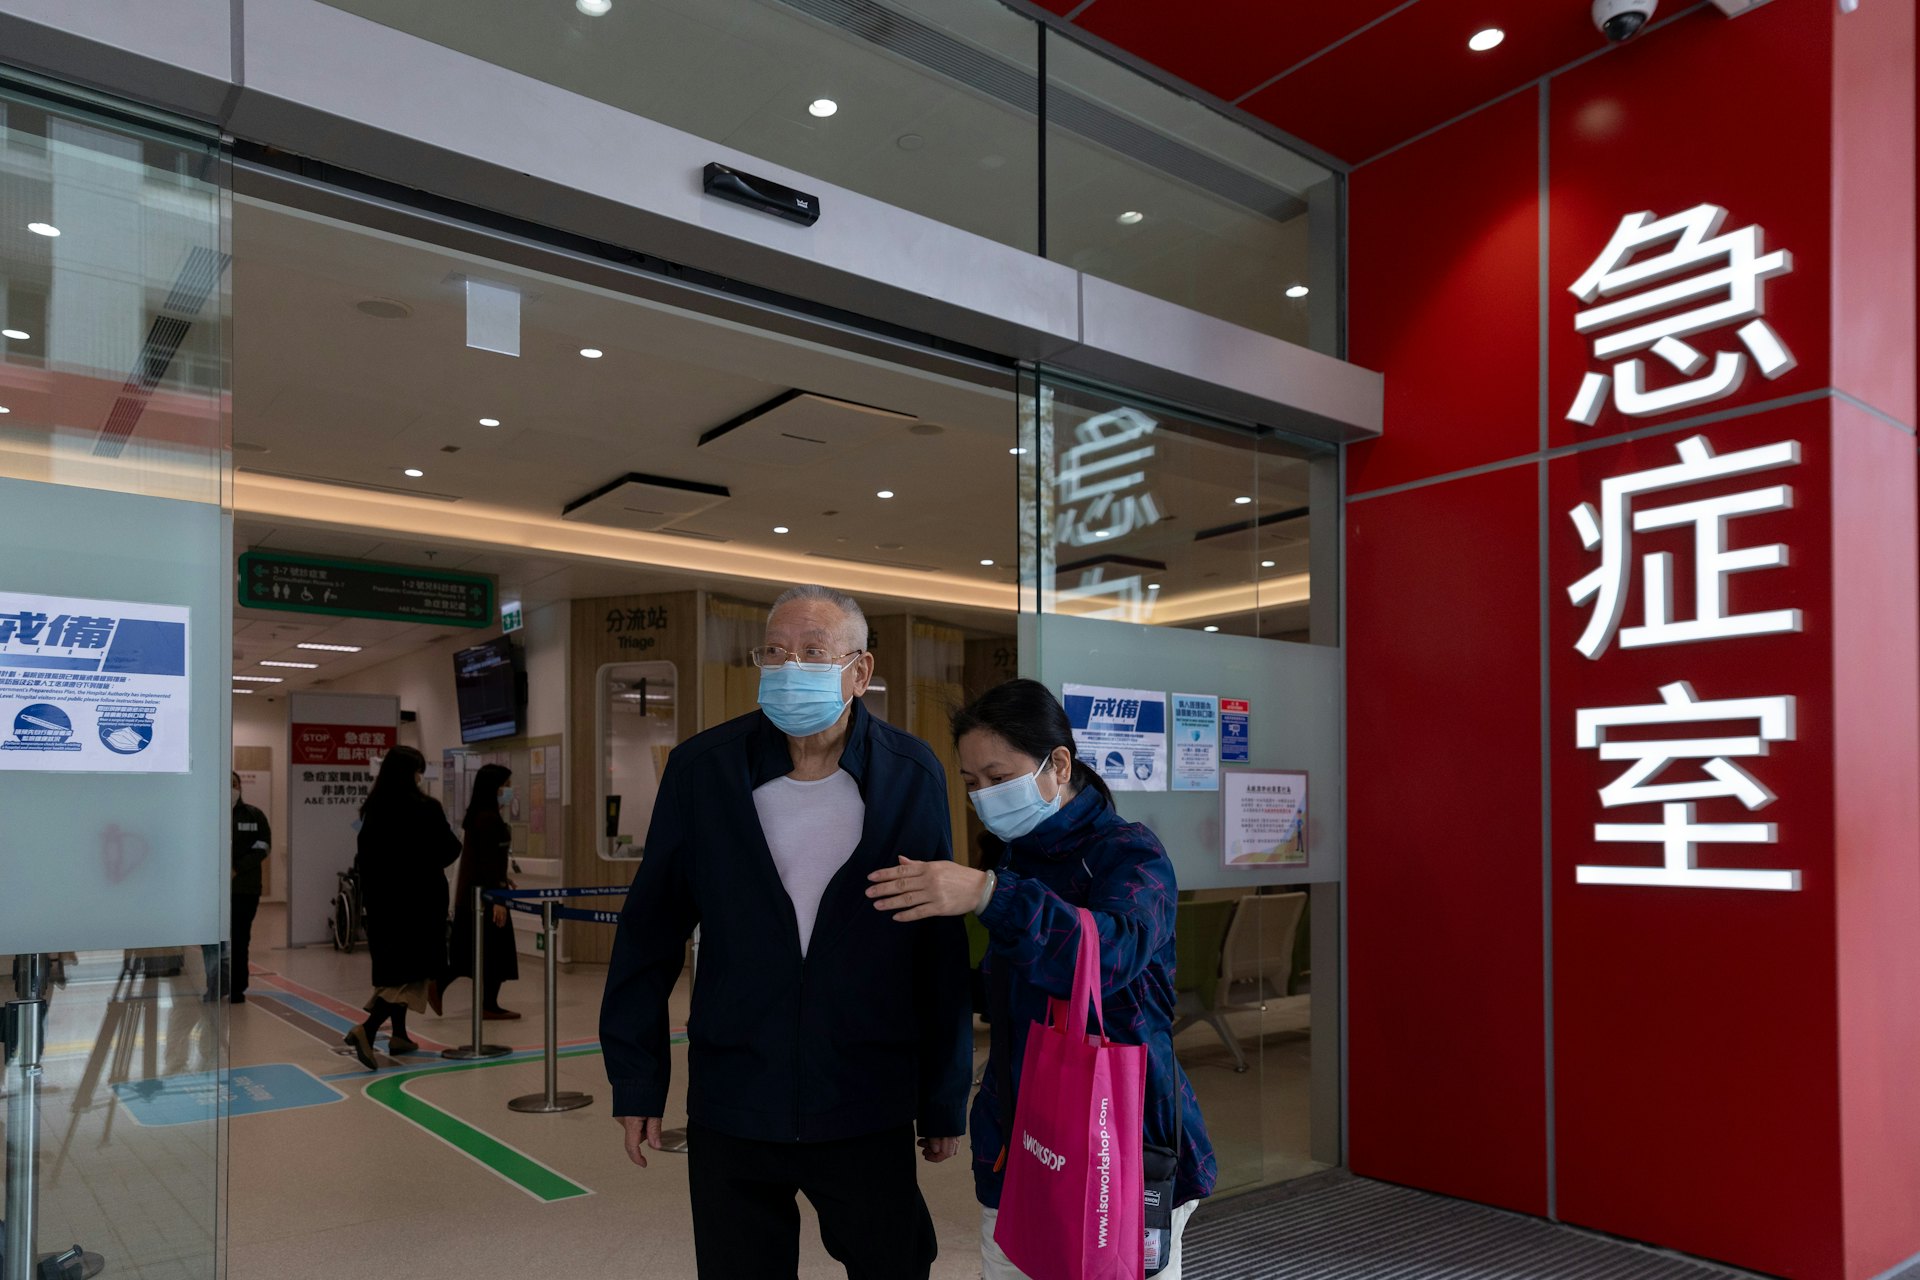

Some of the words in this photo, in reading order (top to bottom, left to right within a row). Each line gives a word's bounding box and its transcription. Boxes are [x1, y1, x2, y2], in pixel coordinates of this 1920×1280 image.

[1565, 202, 1803, 891] 急症室
[606, 605, 668, 632] 分流站
[617, 635, 656, 651] Triage
[1092, 697, 1140, 719] 戒備
[303, 733, 330, 742] STOP
[344, 731, 386, 746] 急症室
[304, 797, 325, 805] A&E
[327, 797, 356, 805] STAFF
[1096, 1098, 1110, 1248] www.isaworkshop.com
